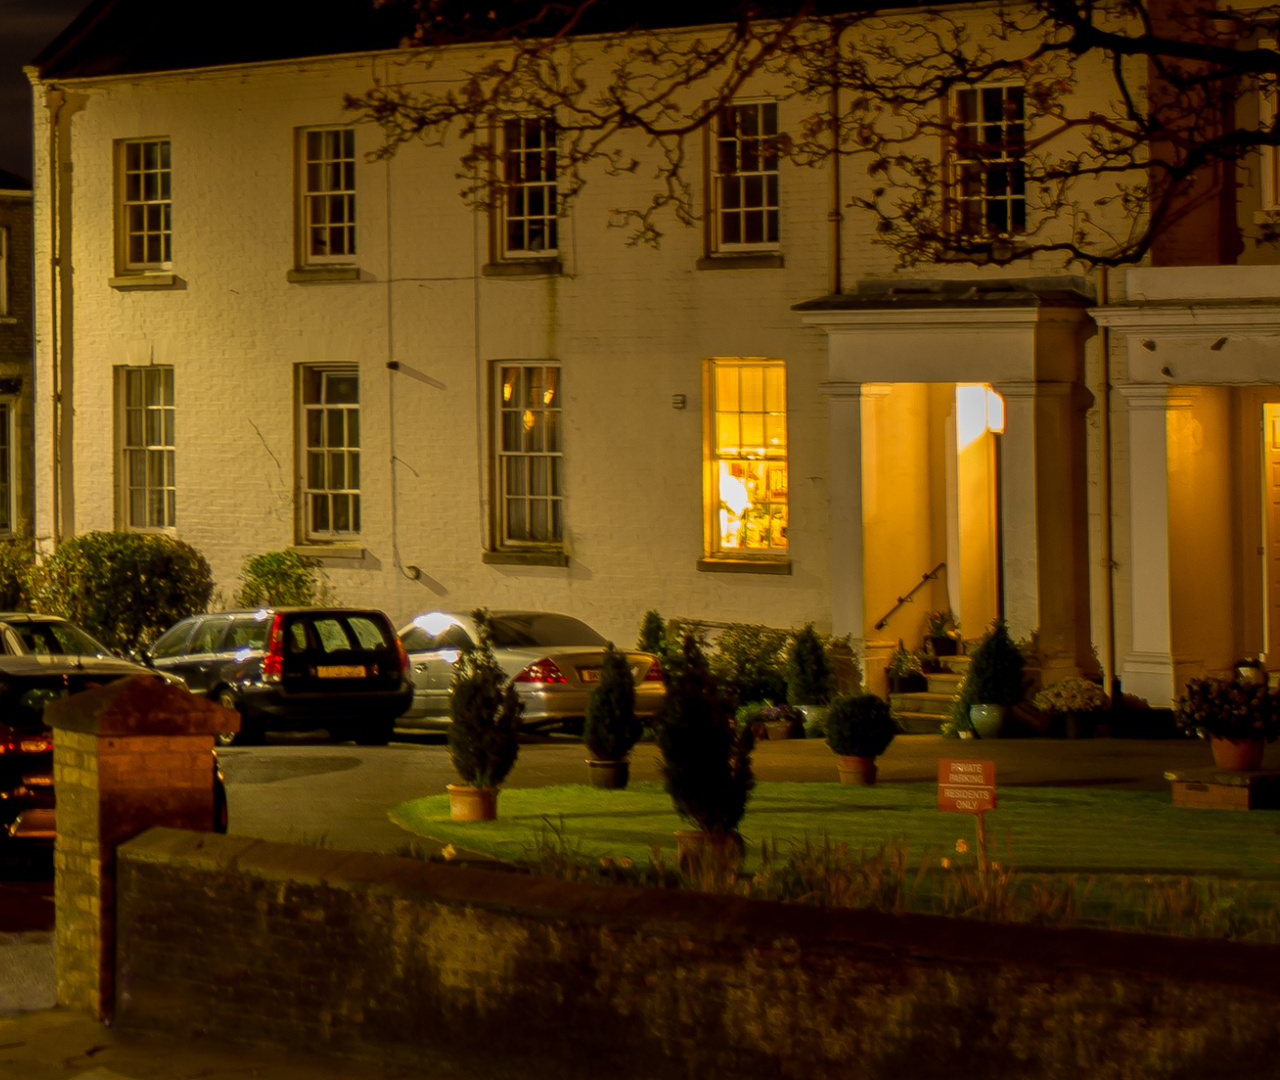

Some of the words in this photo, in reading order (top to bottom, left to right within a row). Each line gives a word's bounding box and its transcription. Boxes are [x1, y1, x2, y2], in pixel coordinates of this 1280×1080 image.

[950, 762, 983, 773] PRIVATE
[948, 773, 985, 784] PARKING
[943, 788, 990, 800] RESIDENTS
[955, 799, 978, 810] ONLY
